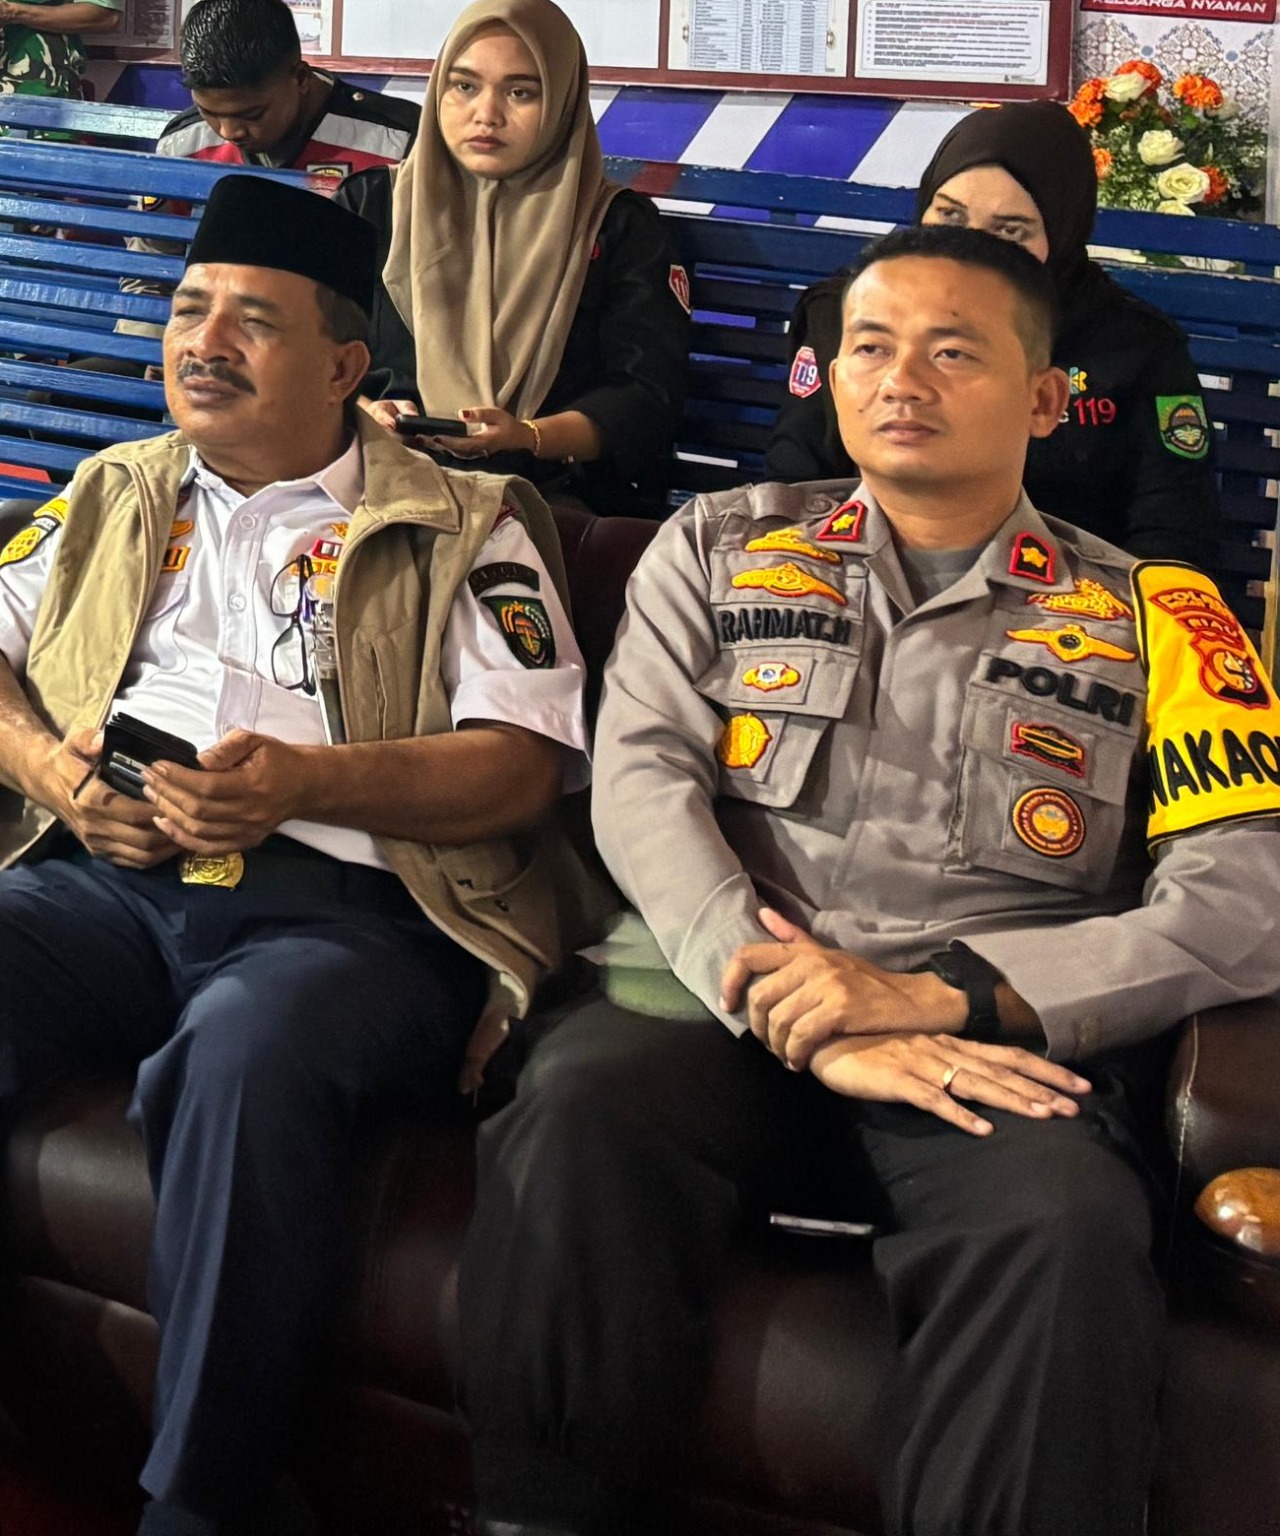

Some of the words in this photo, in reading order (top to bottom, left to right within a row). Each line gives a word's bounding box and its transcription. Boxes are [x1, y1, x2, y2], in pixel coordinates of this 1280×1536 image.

[1191, 0, 1266, 13] NYAMAN
[795, 361, 818, 385] 119
[1074, 397, 1116, 426] 119
[985, 657, 1137, 727] POLRI
